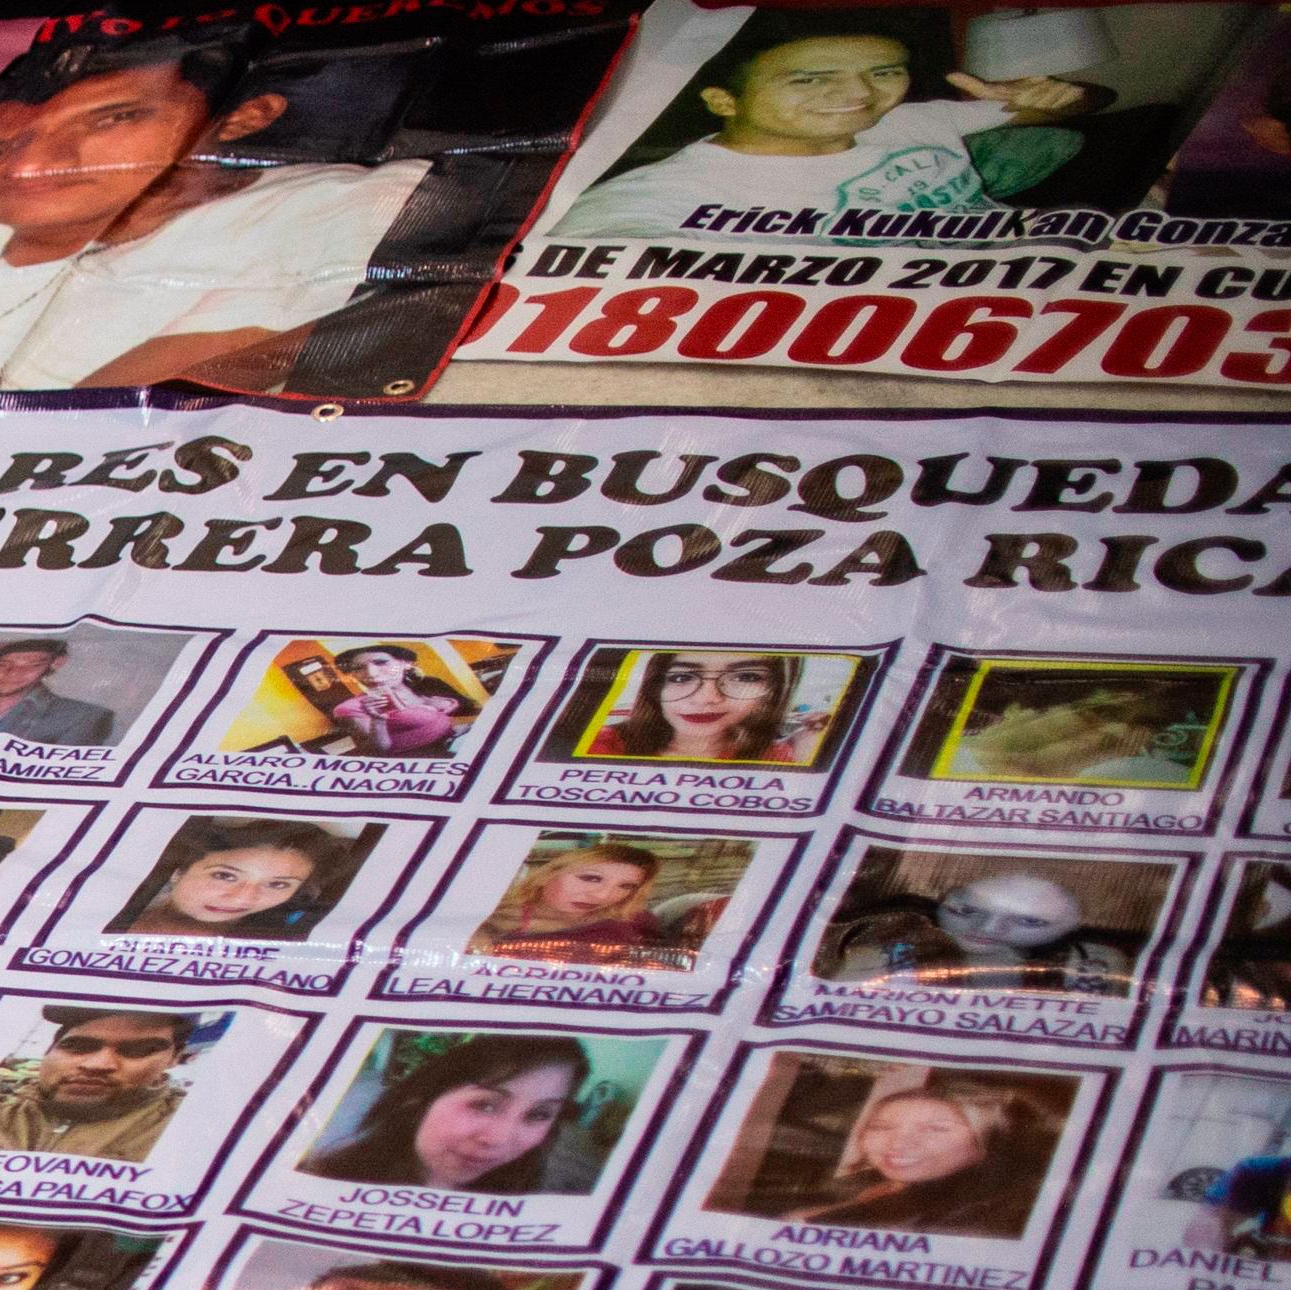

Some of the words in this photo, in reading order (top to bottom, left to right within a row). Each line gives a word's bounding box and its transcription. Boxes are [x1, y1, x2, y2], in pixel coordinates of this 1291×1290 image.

[679, 203, 829, 235] Erick
[827, 206, 1111, 243] KukulKan
[1118, 211, 1291, 248] Gonza
[525, 244, 625, 280] DE
[625, 246, 884, 287] MARZO
[887, 256, 1077, 291] 2017
[1079, 261, 1184, 298] EN
[1195, 266, 1291, 301] CU
[263, 450, 483, 503] EN
[510, 522, 929, 587] POZA
[3, 740, 118, 763] RAFAEL
[182, 752, 307, 770] ALVARO
[311, 756, 469, 777] MORALES
[330, 776, 437, 794] NAOMI
[559, 768, 666, 788] PERLA
[676, 773, 786, 792] PAOLA
[964, 785, 1125, 808] ARMANDO
[519, 785, 679, 806] TOSCANO
[689, 792, 812, 812] COBOS
[874, 797, 1030, 824] BALTAZAR
[1037, 808, 1204, 832] SANTIAGO
[27, 948, 179, 975] GONZALEZ
[179, 958, 332, 990] ARELLANO
[386, 976, 471, 997] LEAL
[481, 982, 711, 1008] HERNANDEZ
[814, 984, 960, 1007] MARION
[971, 992, 1101, 1016] IVETTE
[774, 1002, 947, 1027] SAMPAYO
[955, 1011, 1127, 1043] SALAZAR
[29, 1181, 197, 1212] PALAFOX
[340, 1186, 525, 1219] JOSSELIN
[277, 1199, 420, 1234] ZEPETA
[431, 1220, 561, 1244] LOPEZ
[662, 1235, 830, 1271] GALLOZO
[769, 1223, 933, 1256] ADRIANA
[1129, 1248, 1283, 1283] DANIEL
